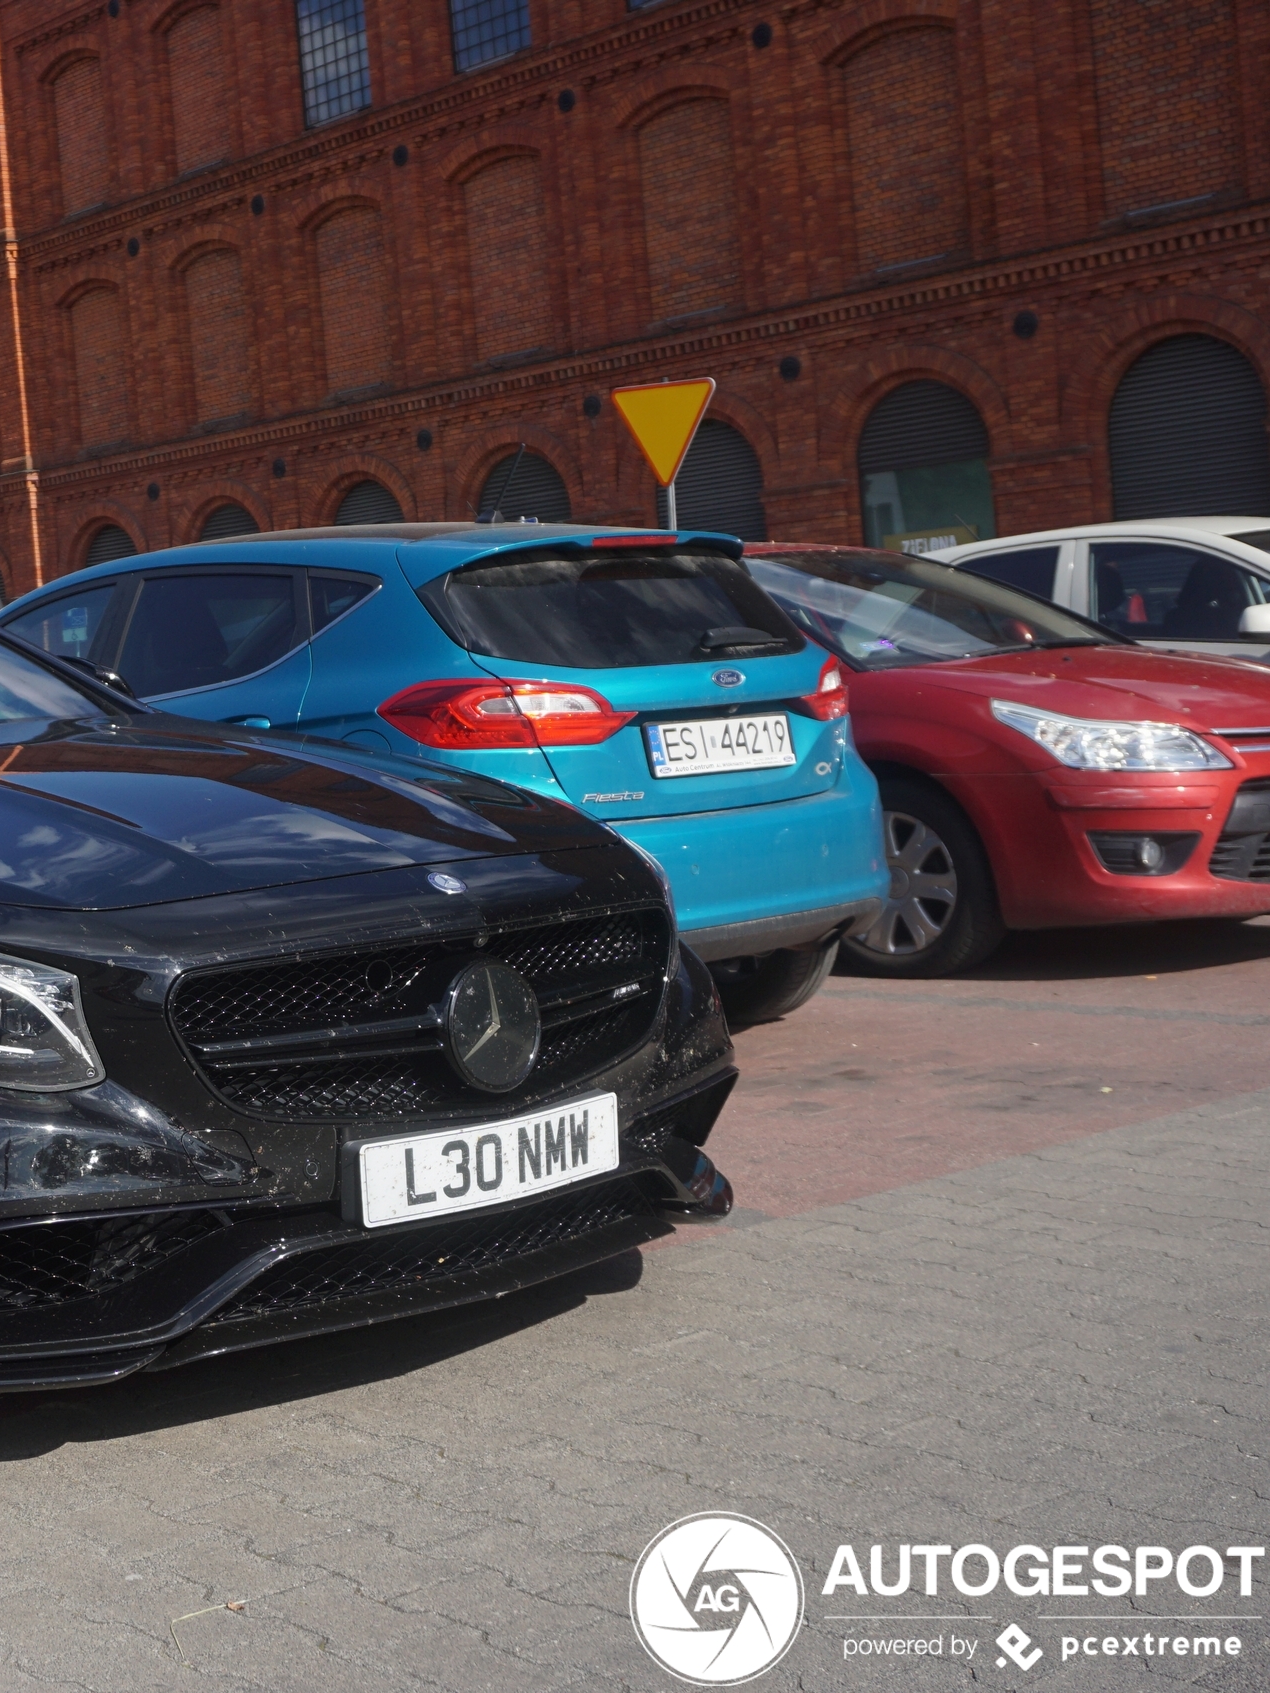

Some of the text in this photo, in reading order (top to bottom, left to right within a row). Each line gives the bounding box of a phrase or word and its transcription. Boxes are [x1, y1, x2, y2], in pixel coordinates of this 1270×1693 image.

[721, 719, 786, 756] 44219
[653, 751, 664, 761] PL
[690, 763, 715, 771] Centrum
[581, 791, 644, 804] Fiesta
[405, 1109, 589, 1206] L30 NMW
